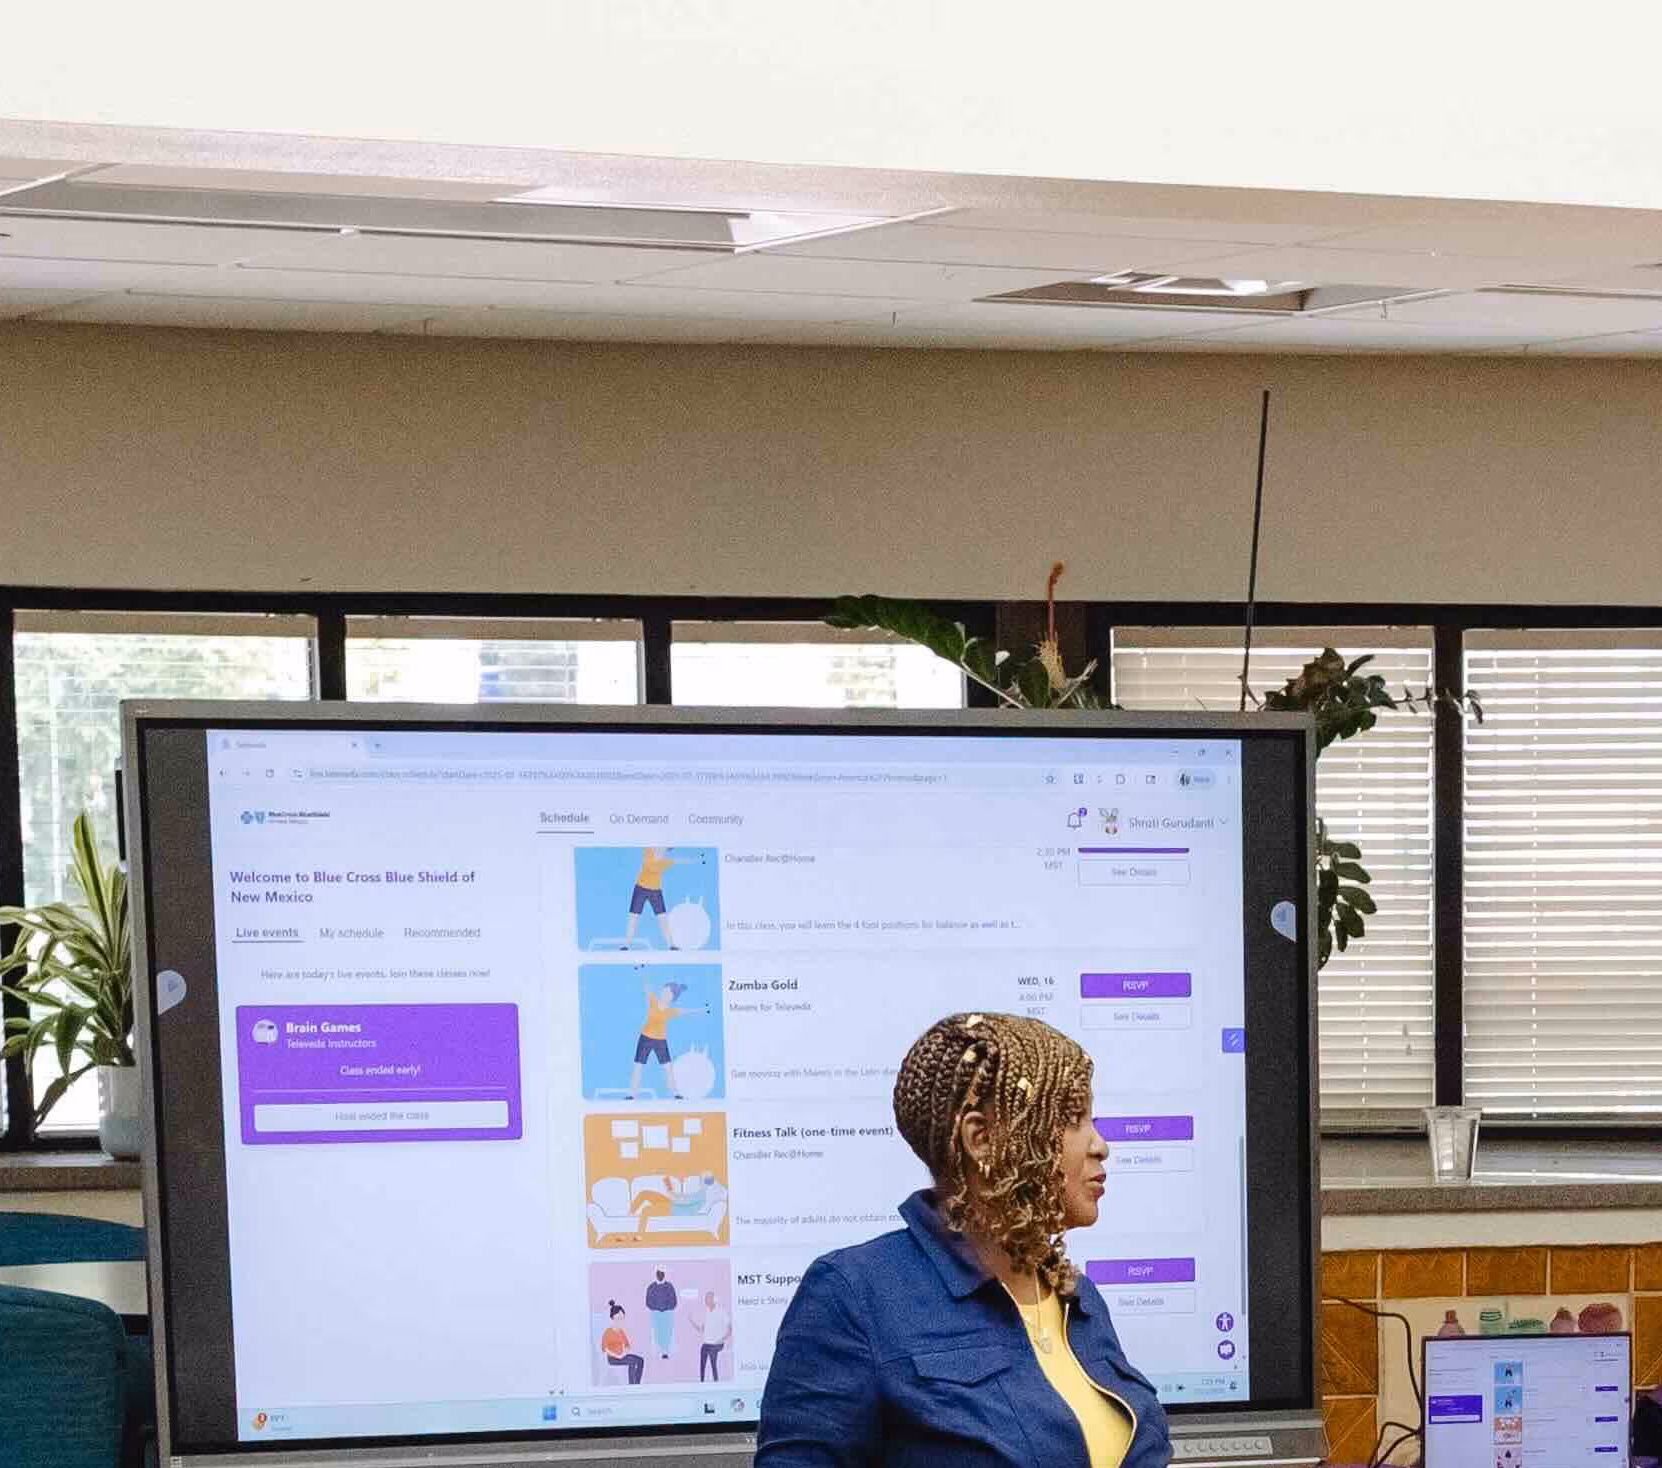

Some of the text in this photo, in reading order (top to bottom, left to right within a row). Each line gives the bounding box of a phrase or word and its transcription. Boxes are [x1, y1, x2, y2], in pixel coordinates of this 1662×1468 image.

[540, 812, 590, 825] Schedule
[609, 813, 669, 825] On Demand
[688, 813, 744, 826] Community
[230, 871, 476, 883] Welcome to Blue Cross Blue Shield of
[230, 891, 314, 903] New Mexico
[235, 927, 299, 939] Live events
[319, 927, 385, 941] My schedule
[404, 927, 481, 939] Recommended
[728, 979, 798, 991] Zumba Gold
[1044, 976, 1055, 985] 16
[286, 1021, 362, 1034] Brain Games
[733, 1126, 893, 1139] Fitness Talk (one-time event)
[1125, 1124, 1151, 1134] RSVP
[1128, 1267, 1155, 1277] RSVP
[738, 1273, 801, 1287] MST Suppo
